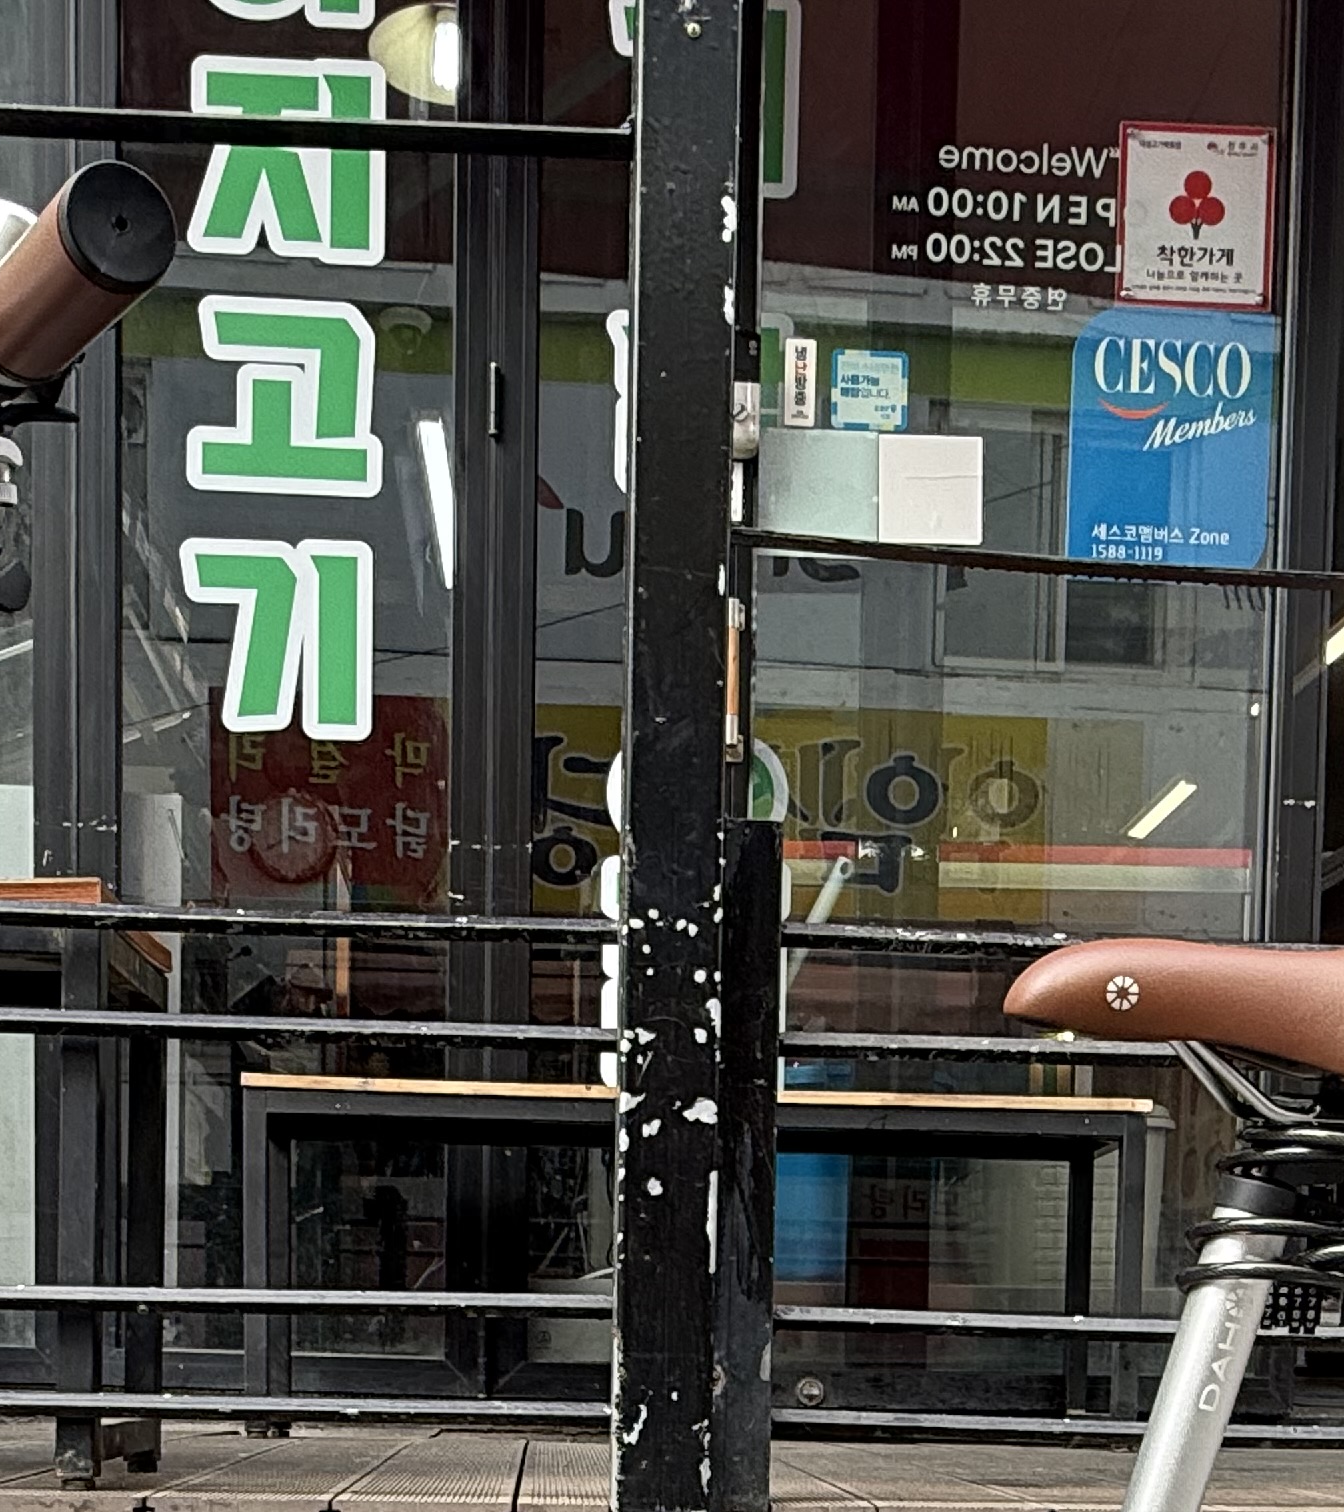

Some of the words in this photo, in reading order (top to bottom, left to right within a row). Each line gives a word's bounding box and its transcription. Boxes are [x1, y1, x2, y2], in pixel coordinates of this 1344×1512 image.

[1156, 245, 1234, 267] 착한가게
[181, 0, 387, 741] 지고기
[1094, 336, 1252, 399] CESCO
[1143, 402, 1256, 451] Members
[1091, 544, 1163, 561] 1588-1119
[1190, 528, 1230, 545] Zone
